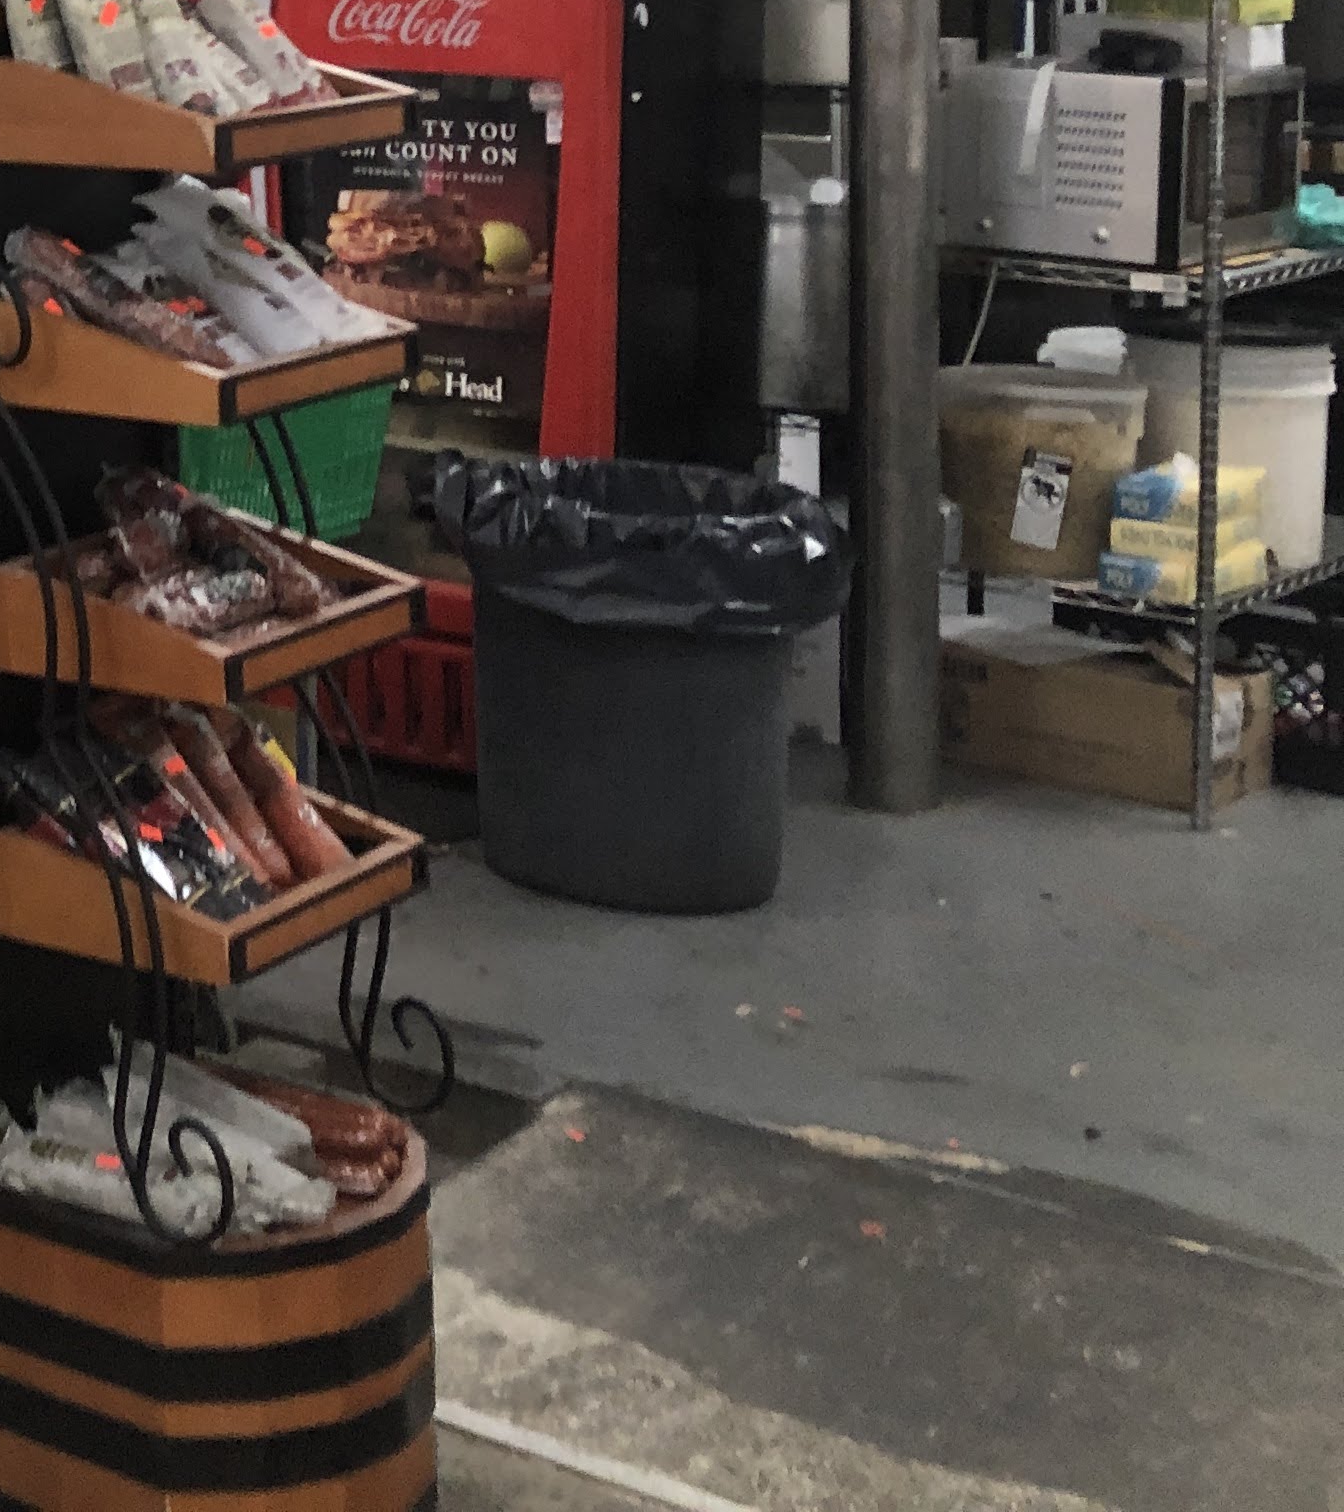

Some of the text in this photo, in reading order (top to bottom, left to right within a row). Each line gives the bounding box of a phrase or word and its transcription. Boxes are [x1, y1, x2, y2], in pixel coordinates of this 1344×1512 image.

[464, 121, 518, 142] YOU
[384, 141, 472, 165] COUNT
[480, 145, 519, 167] ON
[444, 370, 504, 403] Head
